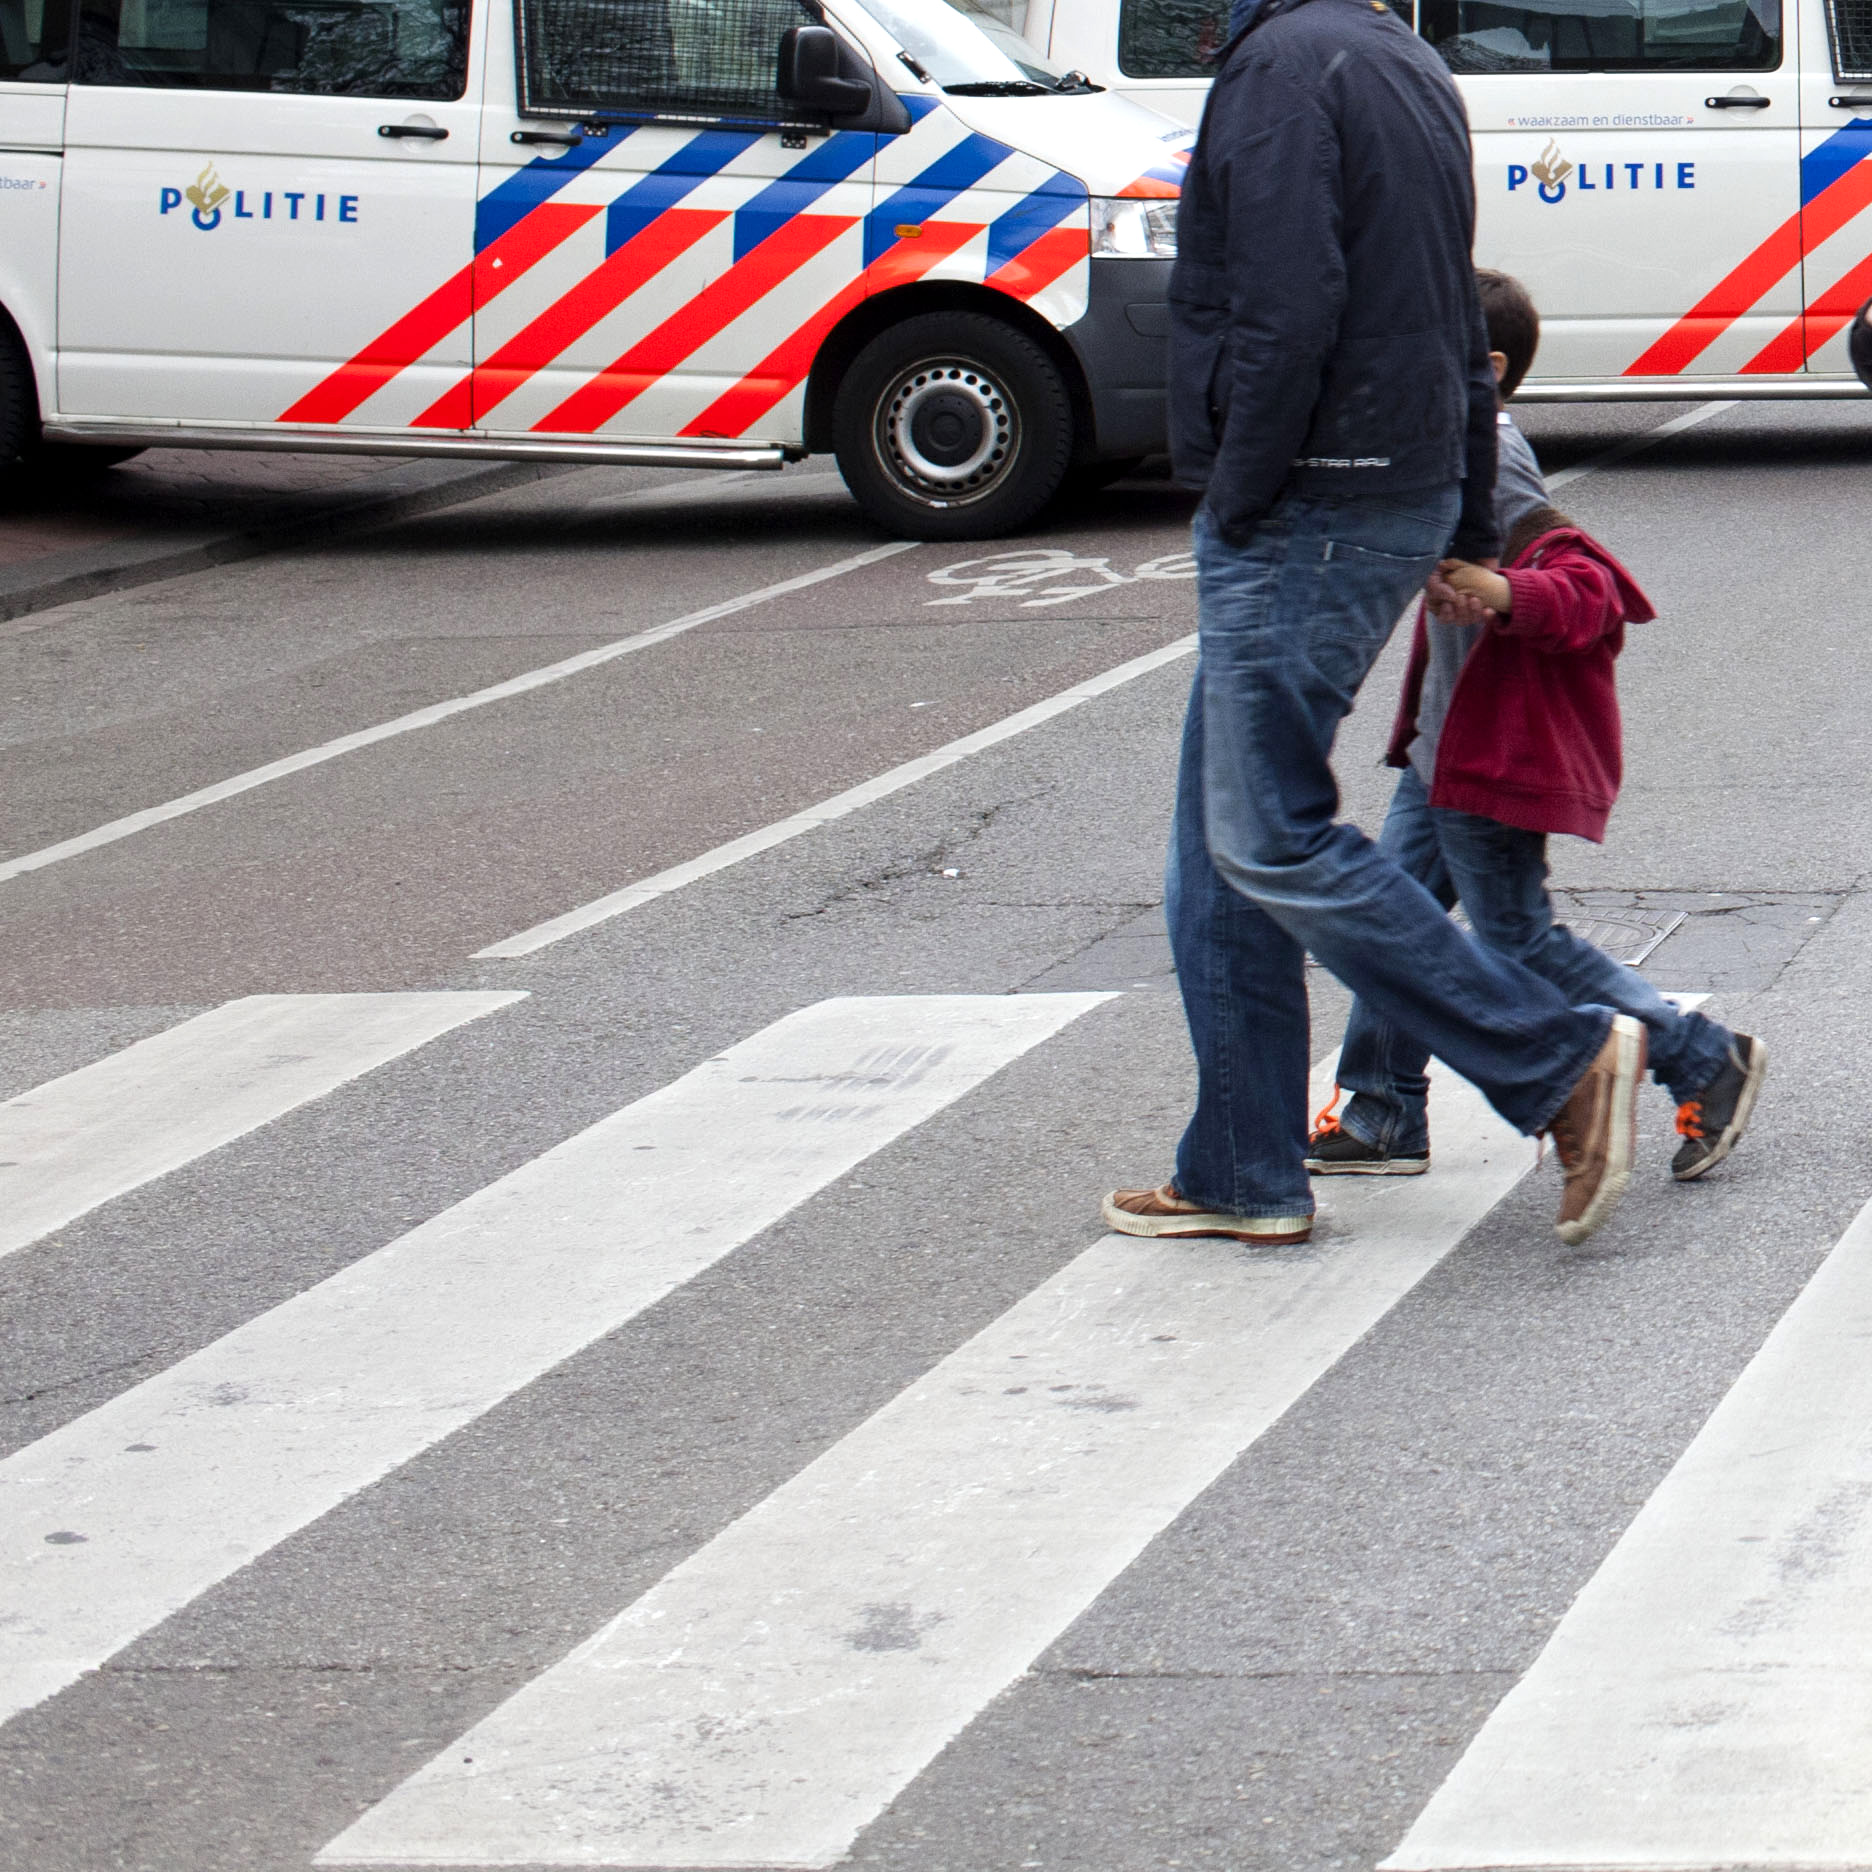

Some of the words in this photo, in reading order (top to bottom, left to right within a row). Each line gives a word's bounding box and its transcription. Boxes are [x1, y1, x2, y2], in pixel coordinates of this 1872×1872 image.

[1518, 115, 1589, 127] waakzaam
[1592, 117, 1609, 126] en
[1612, 113, 1684, 126] dienstbaar
[1507, 162, 1695, 205] POLITIE
[160, 186, 359, 231] POLITIE
